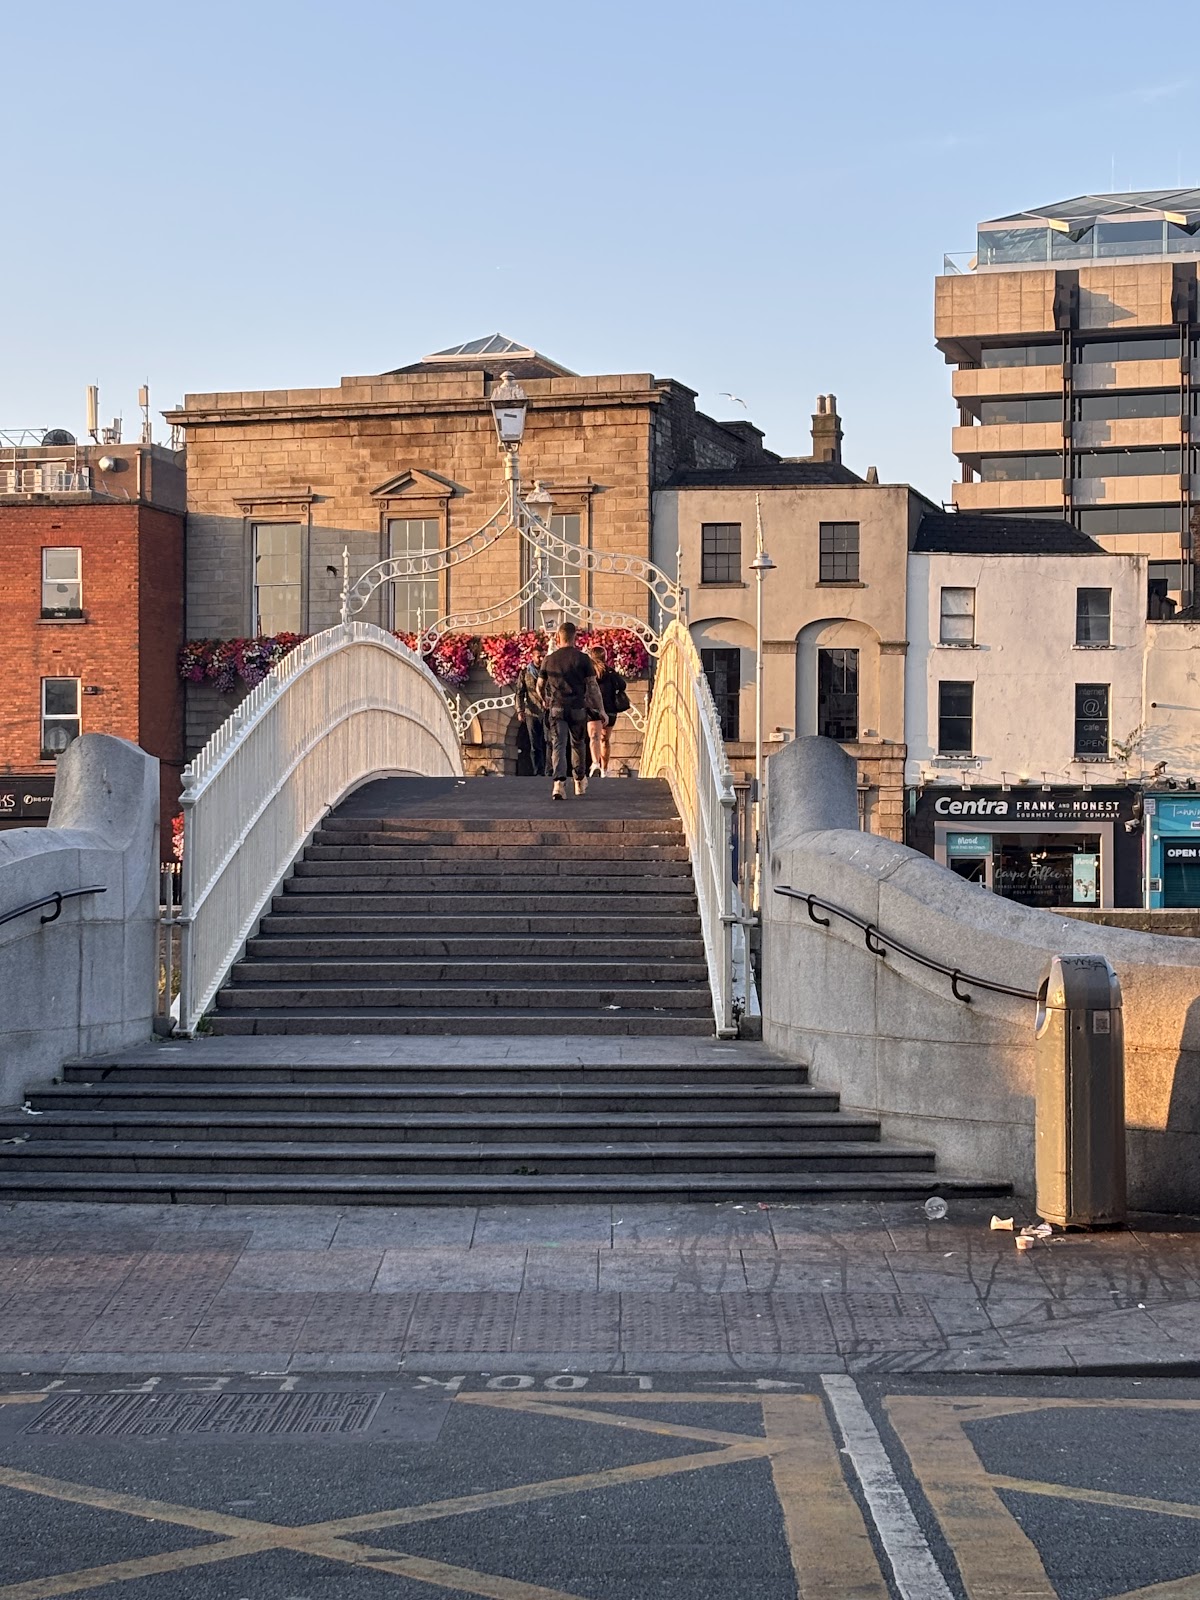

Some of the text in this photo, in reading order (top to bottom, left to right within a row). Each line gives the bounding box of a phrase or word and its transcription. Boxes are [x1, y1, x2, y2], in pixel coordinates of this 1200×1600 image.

[1078, 739, 1105, 747] OPEN
[935, 797, 1008, 814] Centra
[1016, 801, 1056, 811] FRANK
[1073, 801, 1120, 811] HONEST
[1167, 848, 1196, 857] OPEN
[995, 867, 1027, 881] Carpe
[411, 1375, 652, 1390] LOOK
